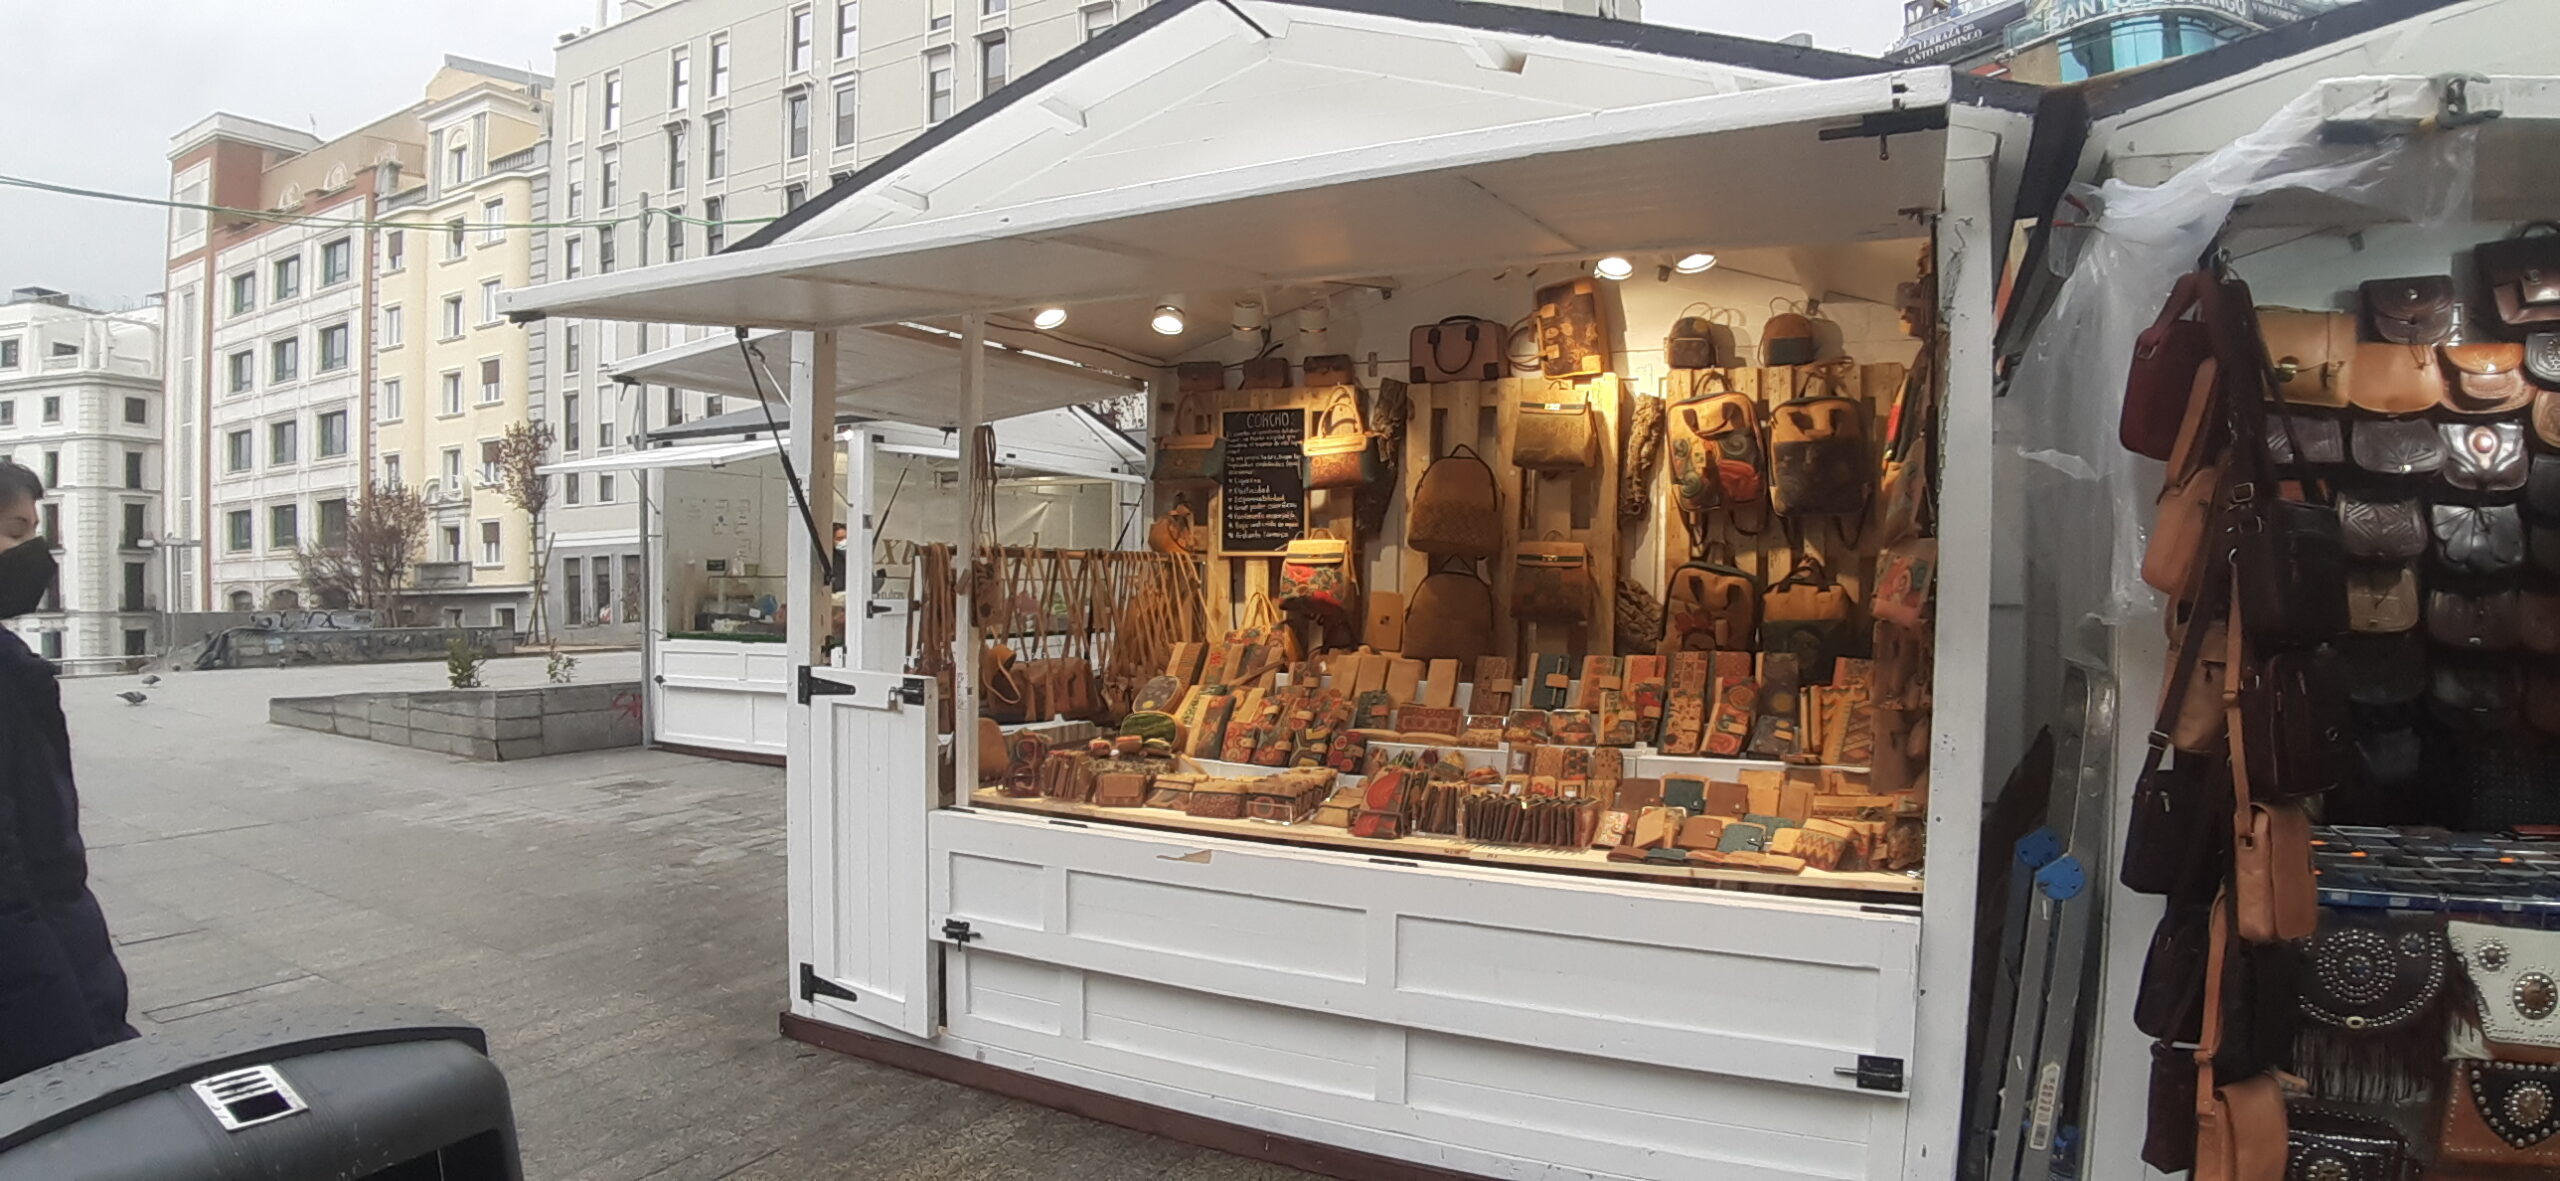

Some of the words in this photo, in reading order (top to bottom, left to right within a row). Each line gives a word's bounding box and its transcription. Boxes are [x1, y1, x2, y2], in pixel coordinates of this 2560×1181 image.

[1903, 48, 1934, 65] SANTO
[1935, 28, 1983, 54] DOMINGO
[1918, 26, 1961, 51] TERRAZA
